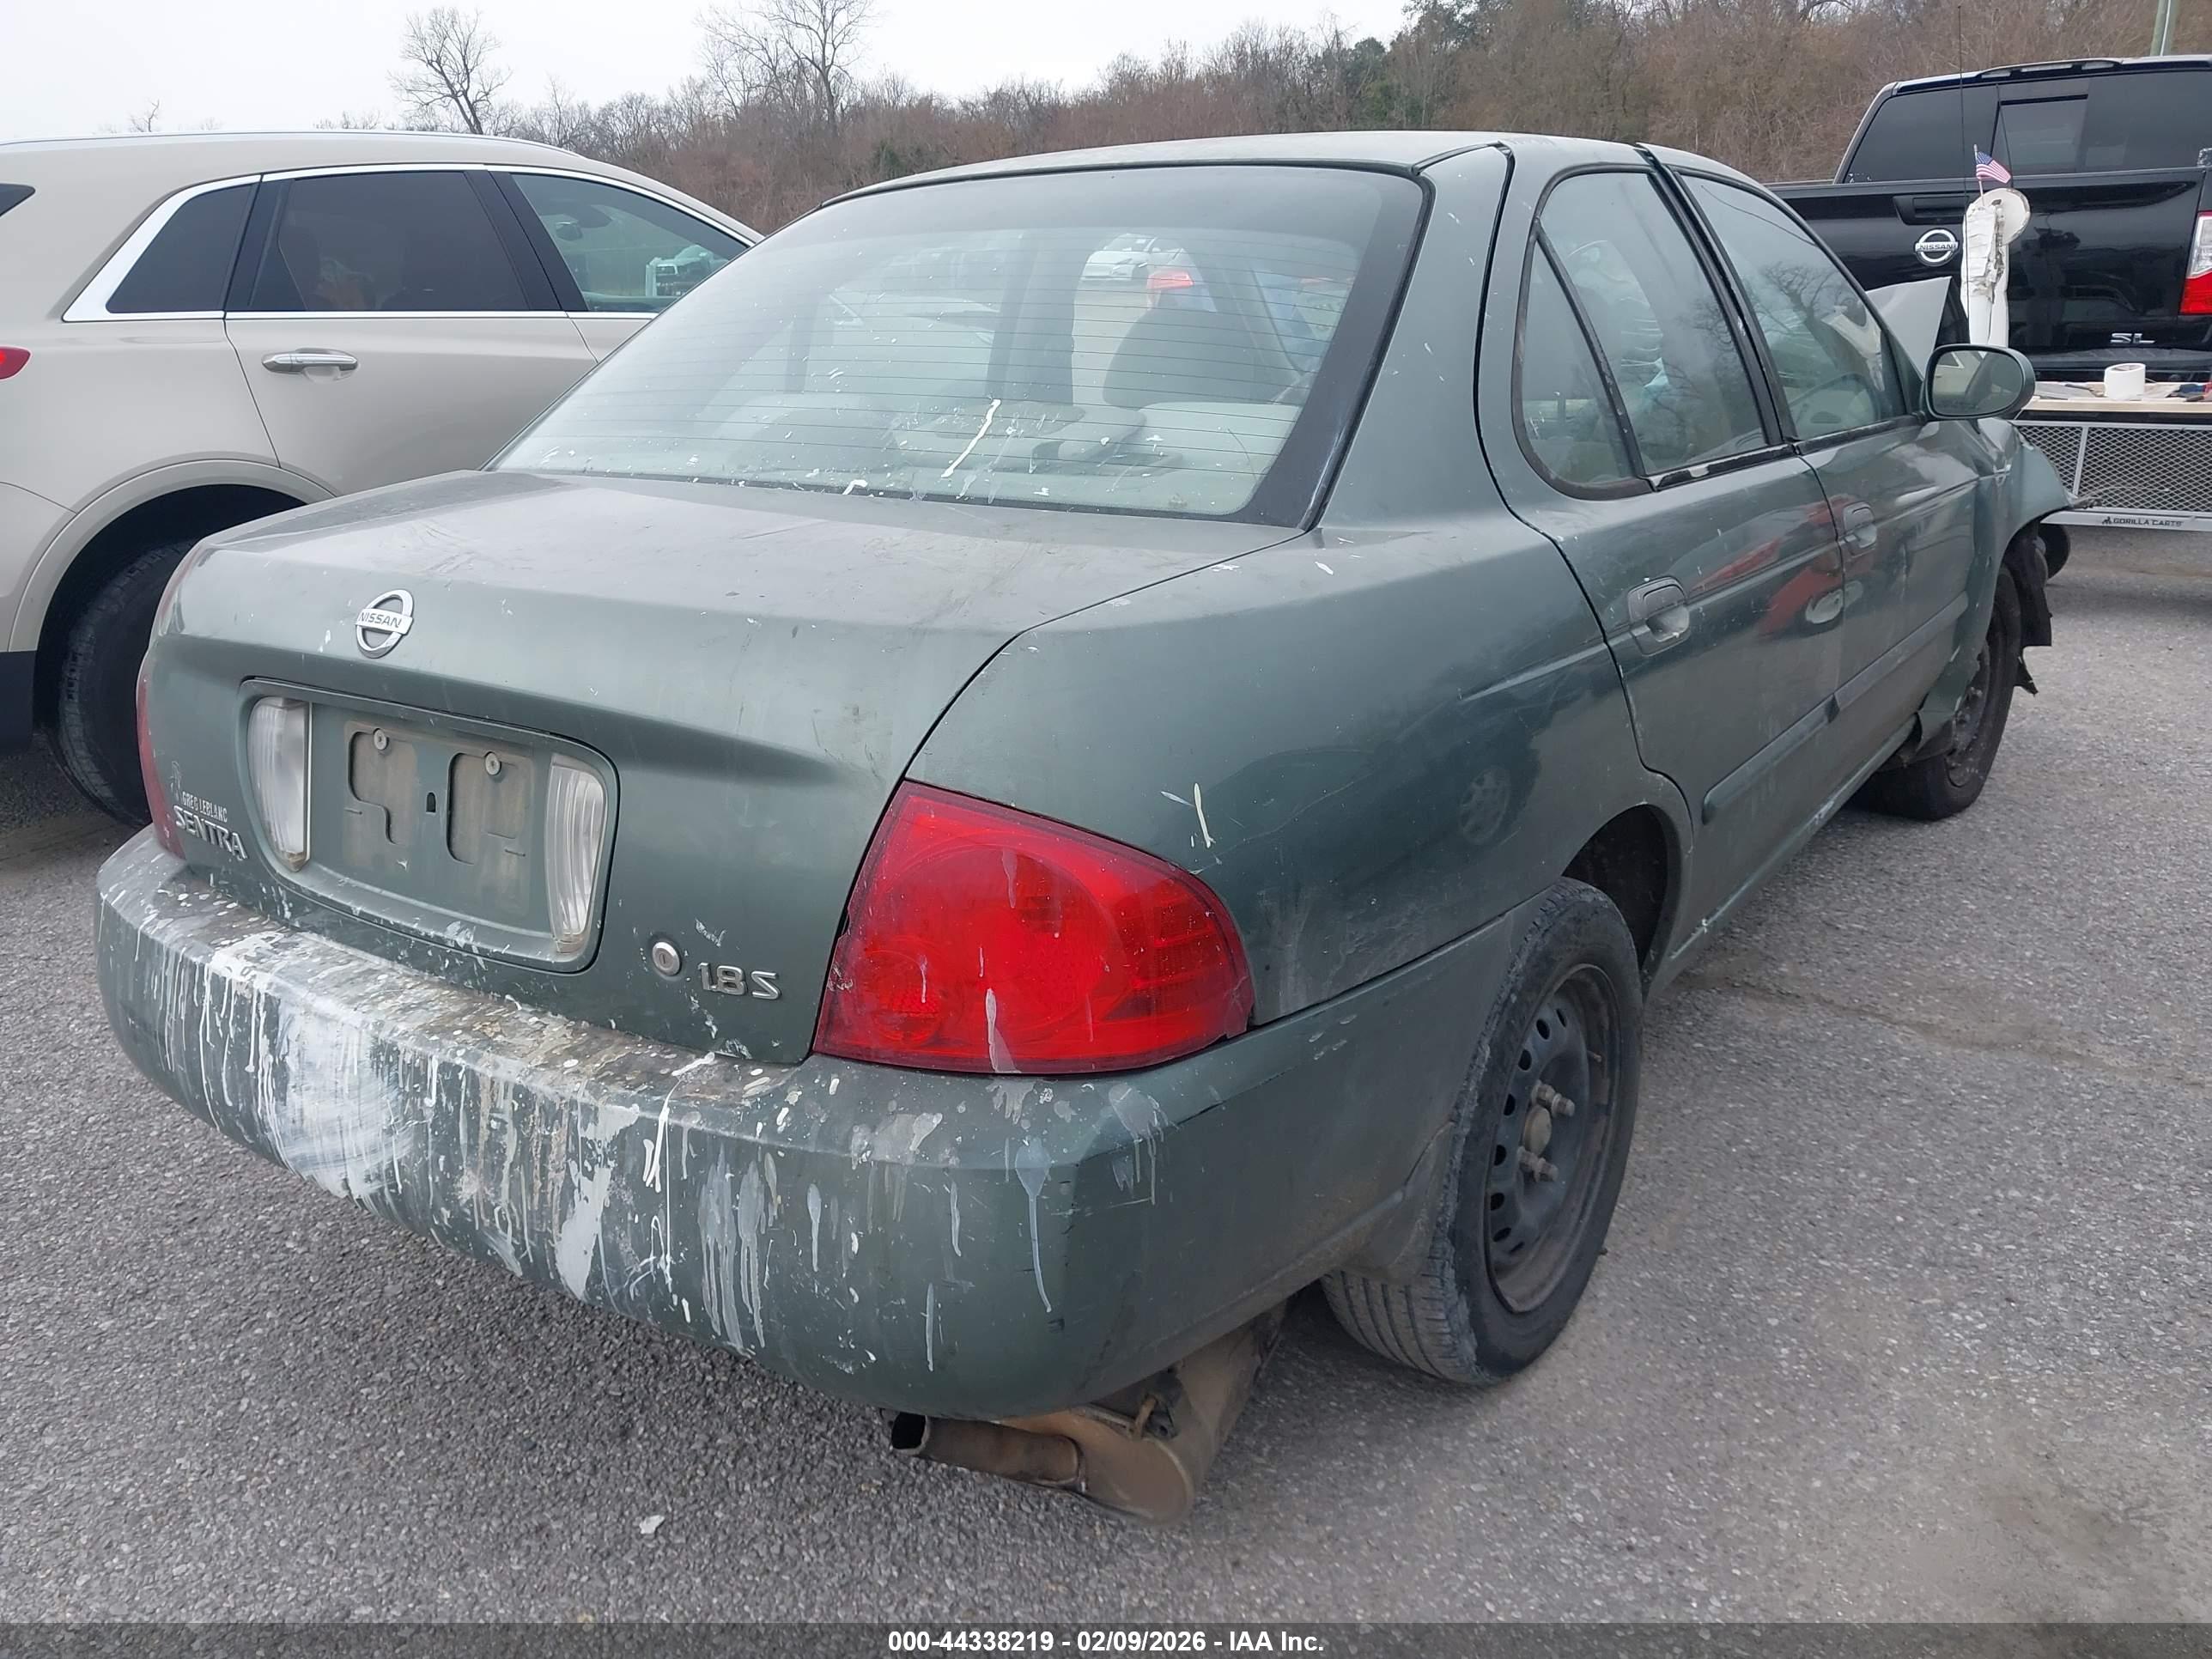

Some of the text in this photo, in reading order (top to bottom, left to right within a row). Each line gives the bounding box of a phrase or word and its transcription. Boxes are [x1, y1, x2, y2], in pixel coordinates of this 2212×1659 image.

[2110, 332, 2155, 343] SL
[358, 611, 402, 628] NISSAN
[182, 791, 228, 823] GREG LEBLANC
[173, 805, 247, 860] SENTRA
